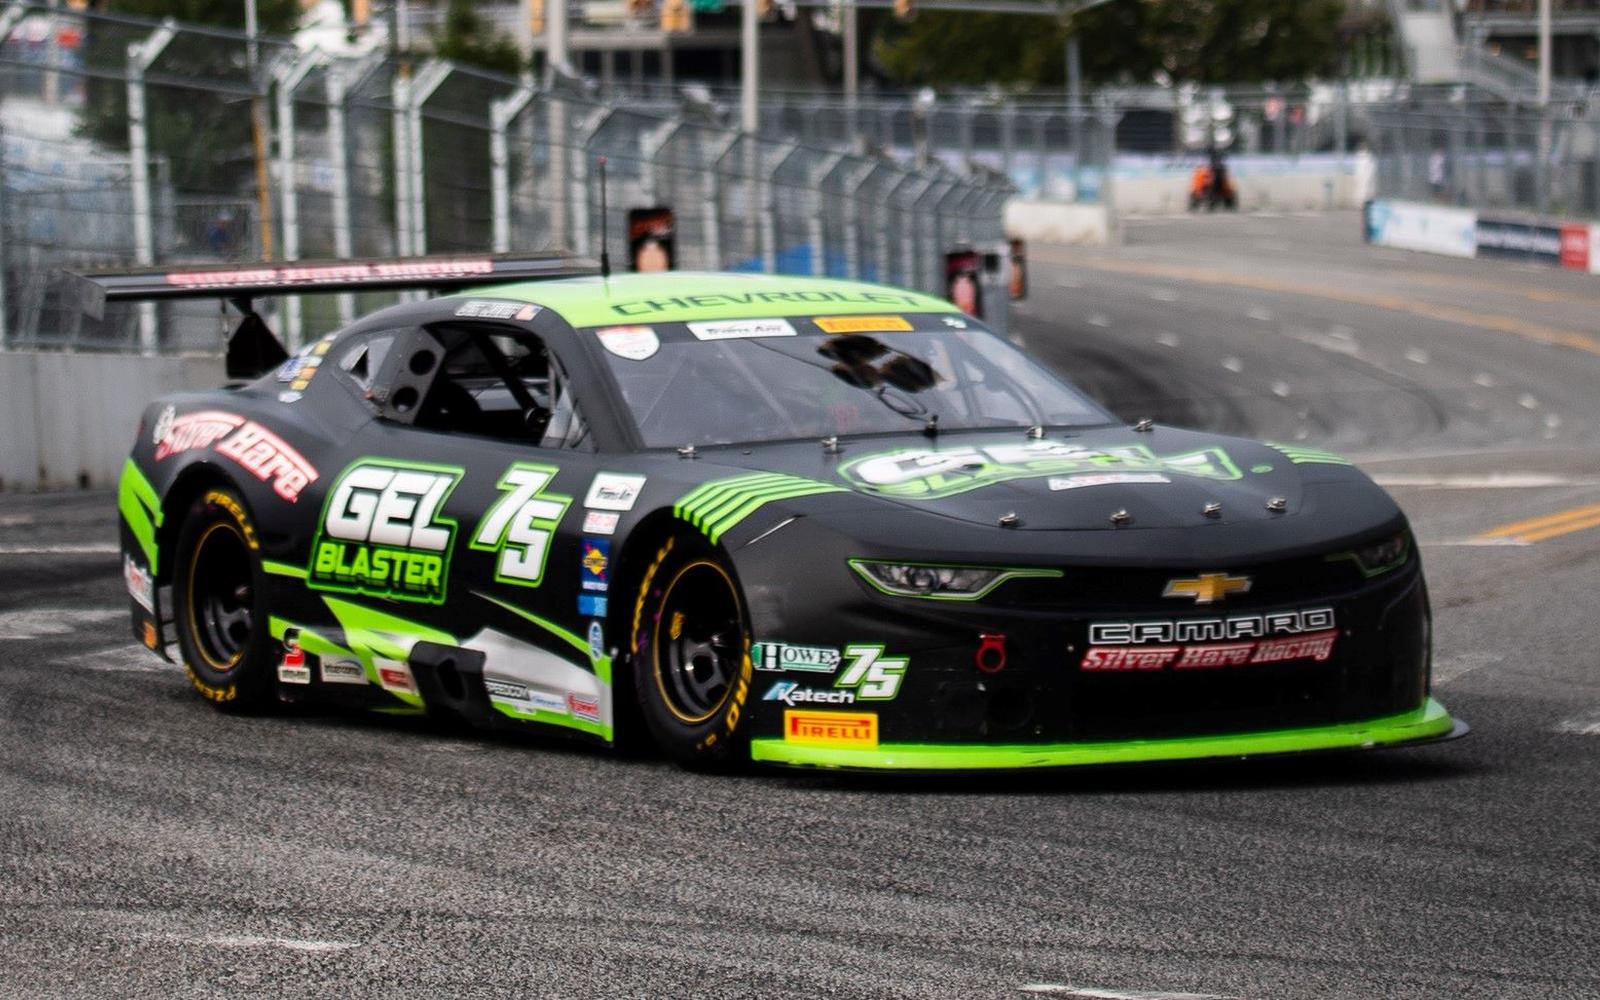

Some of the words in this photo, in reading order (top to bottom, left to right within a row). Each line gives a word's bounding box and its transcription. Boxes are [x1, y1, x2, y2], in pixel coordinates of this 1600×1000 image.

[611, 291, 920, 317] CHEVROLET
[213, 419, 321, 504] Hare
[325, 466, 457, 551] GEL
[473, 465, 569, 584] 75
[314, 541, 444, 589] BLASTER
[1089, 608, 1335, 645] CAMARO
[755, 642, 832, 672] HOWE
[1081, 647, 1180, 670] Silver
[1174, 643, 1256, 668] Hare
[1250, 631, 1339, 664] Racing
[837, 646, 908, 699] 75
[773, 683, 855, 707] Katech
[790, 716, 871, 740] PIRELLI
